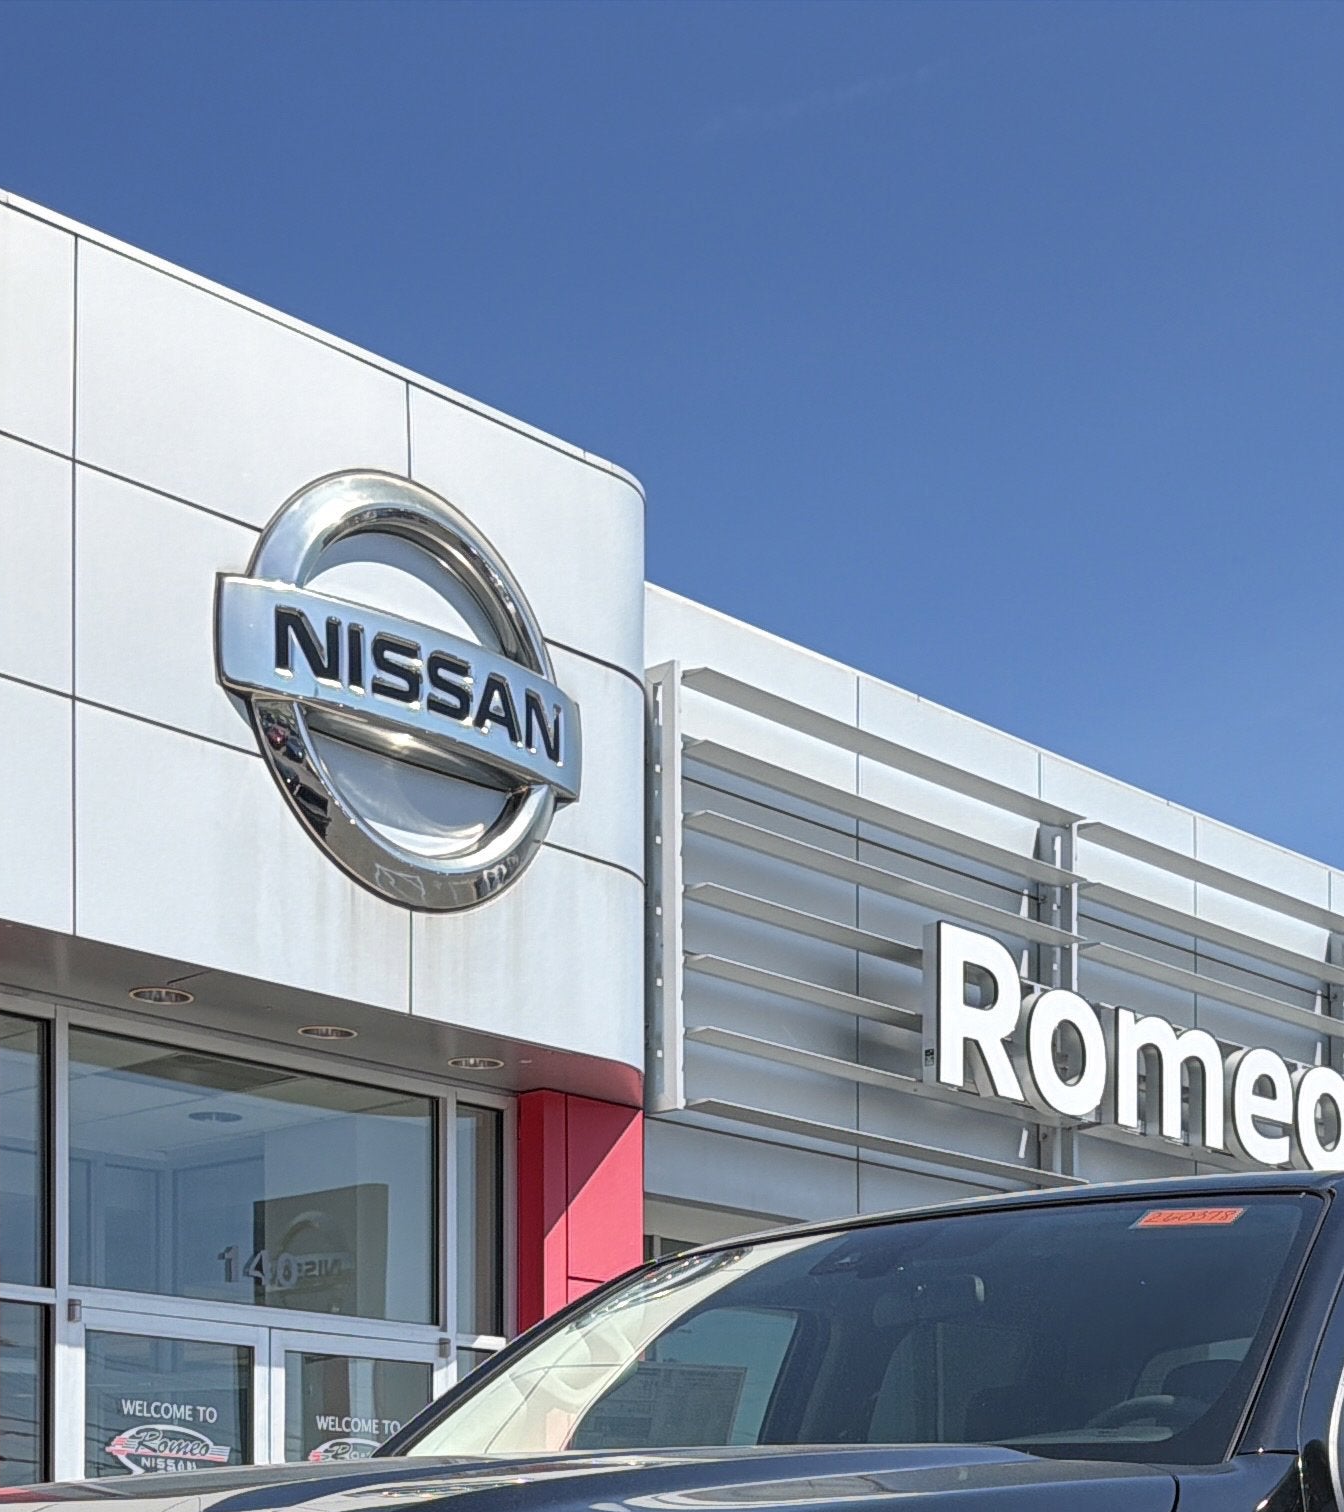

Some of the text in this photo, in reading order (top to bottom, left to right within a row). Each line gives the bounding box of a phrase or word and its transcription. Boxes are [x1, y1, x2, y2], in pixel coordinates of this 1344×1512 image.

[274, 603, 564, 767] NISSAN
[219, 1246, 298, 1288] 140
[122, 1399, 218, 1424] WELCOME TO
[316, 1415, 401, 1436] WELCOME TO
[129, 1427, 210, 1457] Romeo
